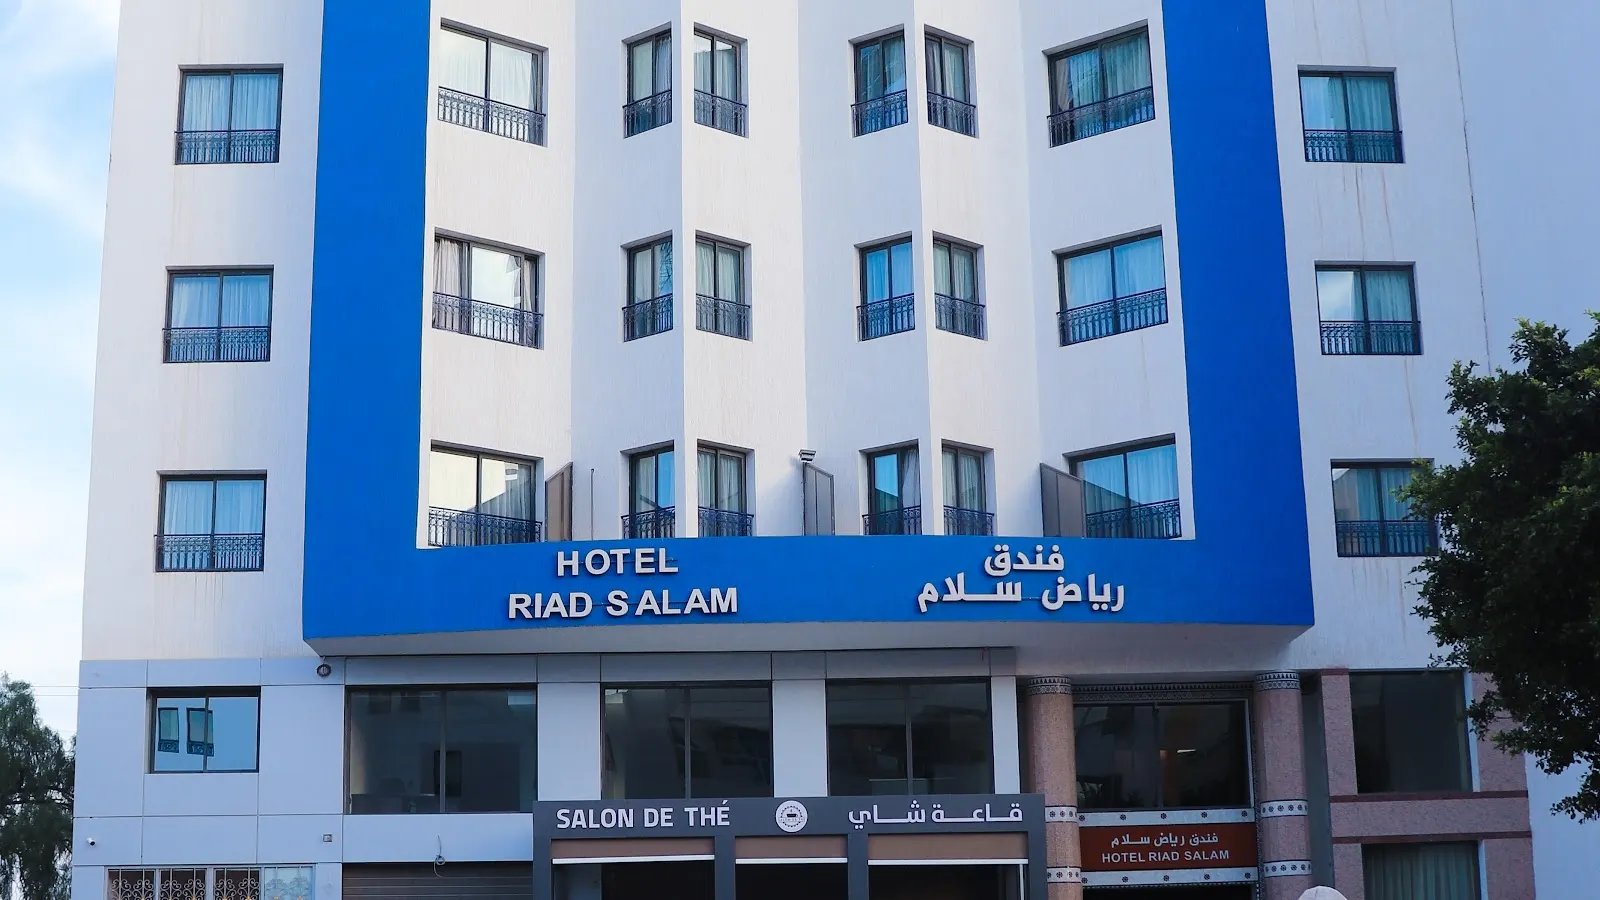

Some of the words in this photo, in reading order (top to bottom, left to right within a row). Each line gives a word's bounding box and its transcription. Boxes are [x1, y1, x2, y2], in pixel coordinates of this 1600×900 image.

[557, 547, 679, 577] HOTEL
[984, 544, 1065, 577] فندق
[508, 592, 592, 619] RIAD
[606, 587, 738, 617] SALAM
[917, 572, 1022, 613] سلام
[1041, 573, 1125, 612] رياض
[556, 808, 634, 829] SALON
[644, 808, 674, 828] DE
[684, 800, 730, 826] THÉ
[848, 800, 926, 830] شاي
[931, 802, 1023, 823] قاعة
[1111, 833, 1150, 848] سلام
[1153, 832, 1185, 847] رياض
[1189, 833, 1219, 846] فندق
[1102, 852, 1145, 863] HOTEL
[1148, 851, 1180, 862] RIAD
[1184, 850, 1229, 861] SALAM
